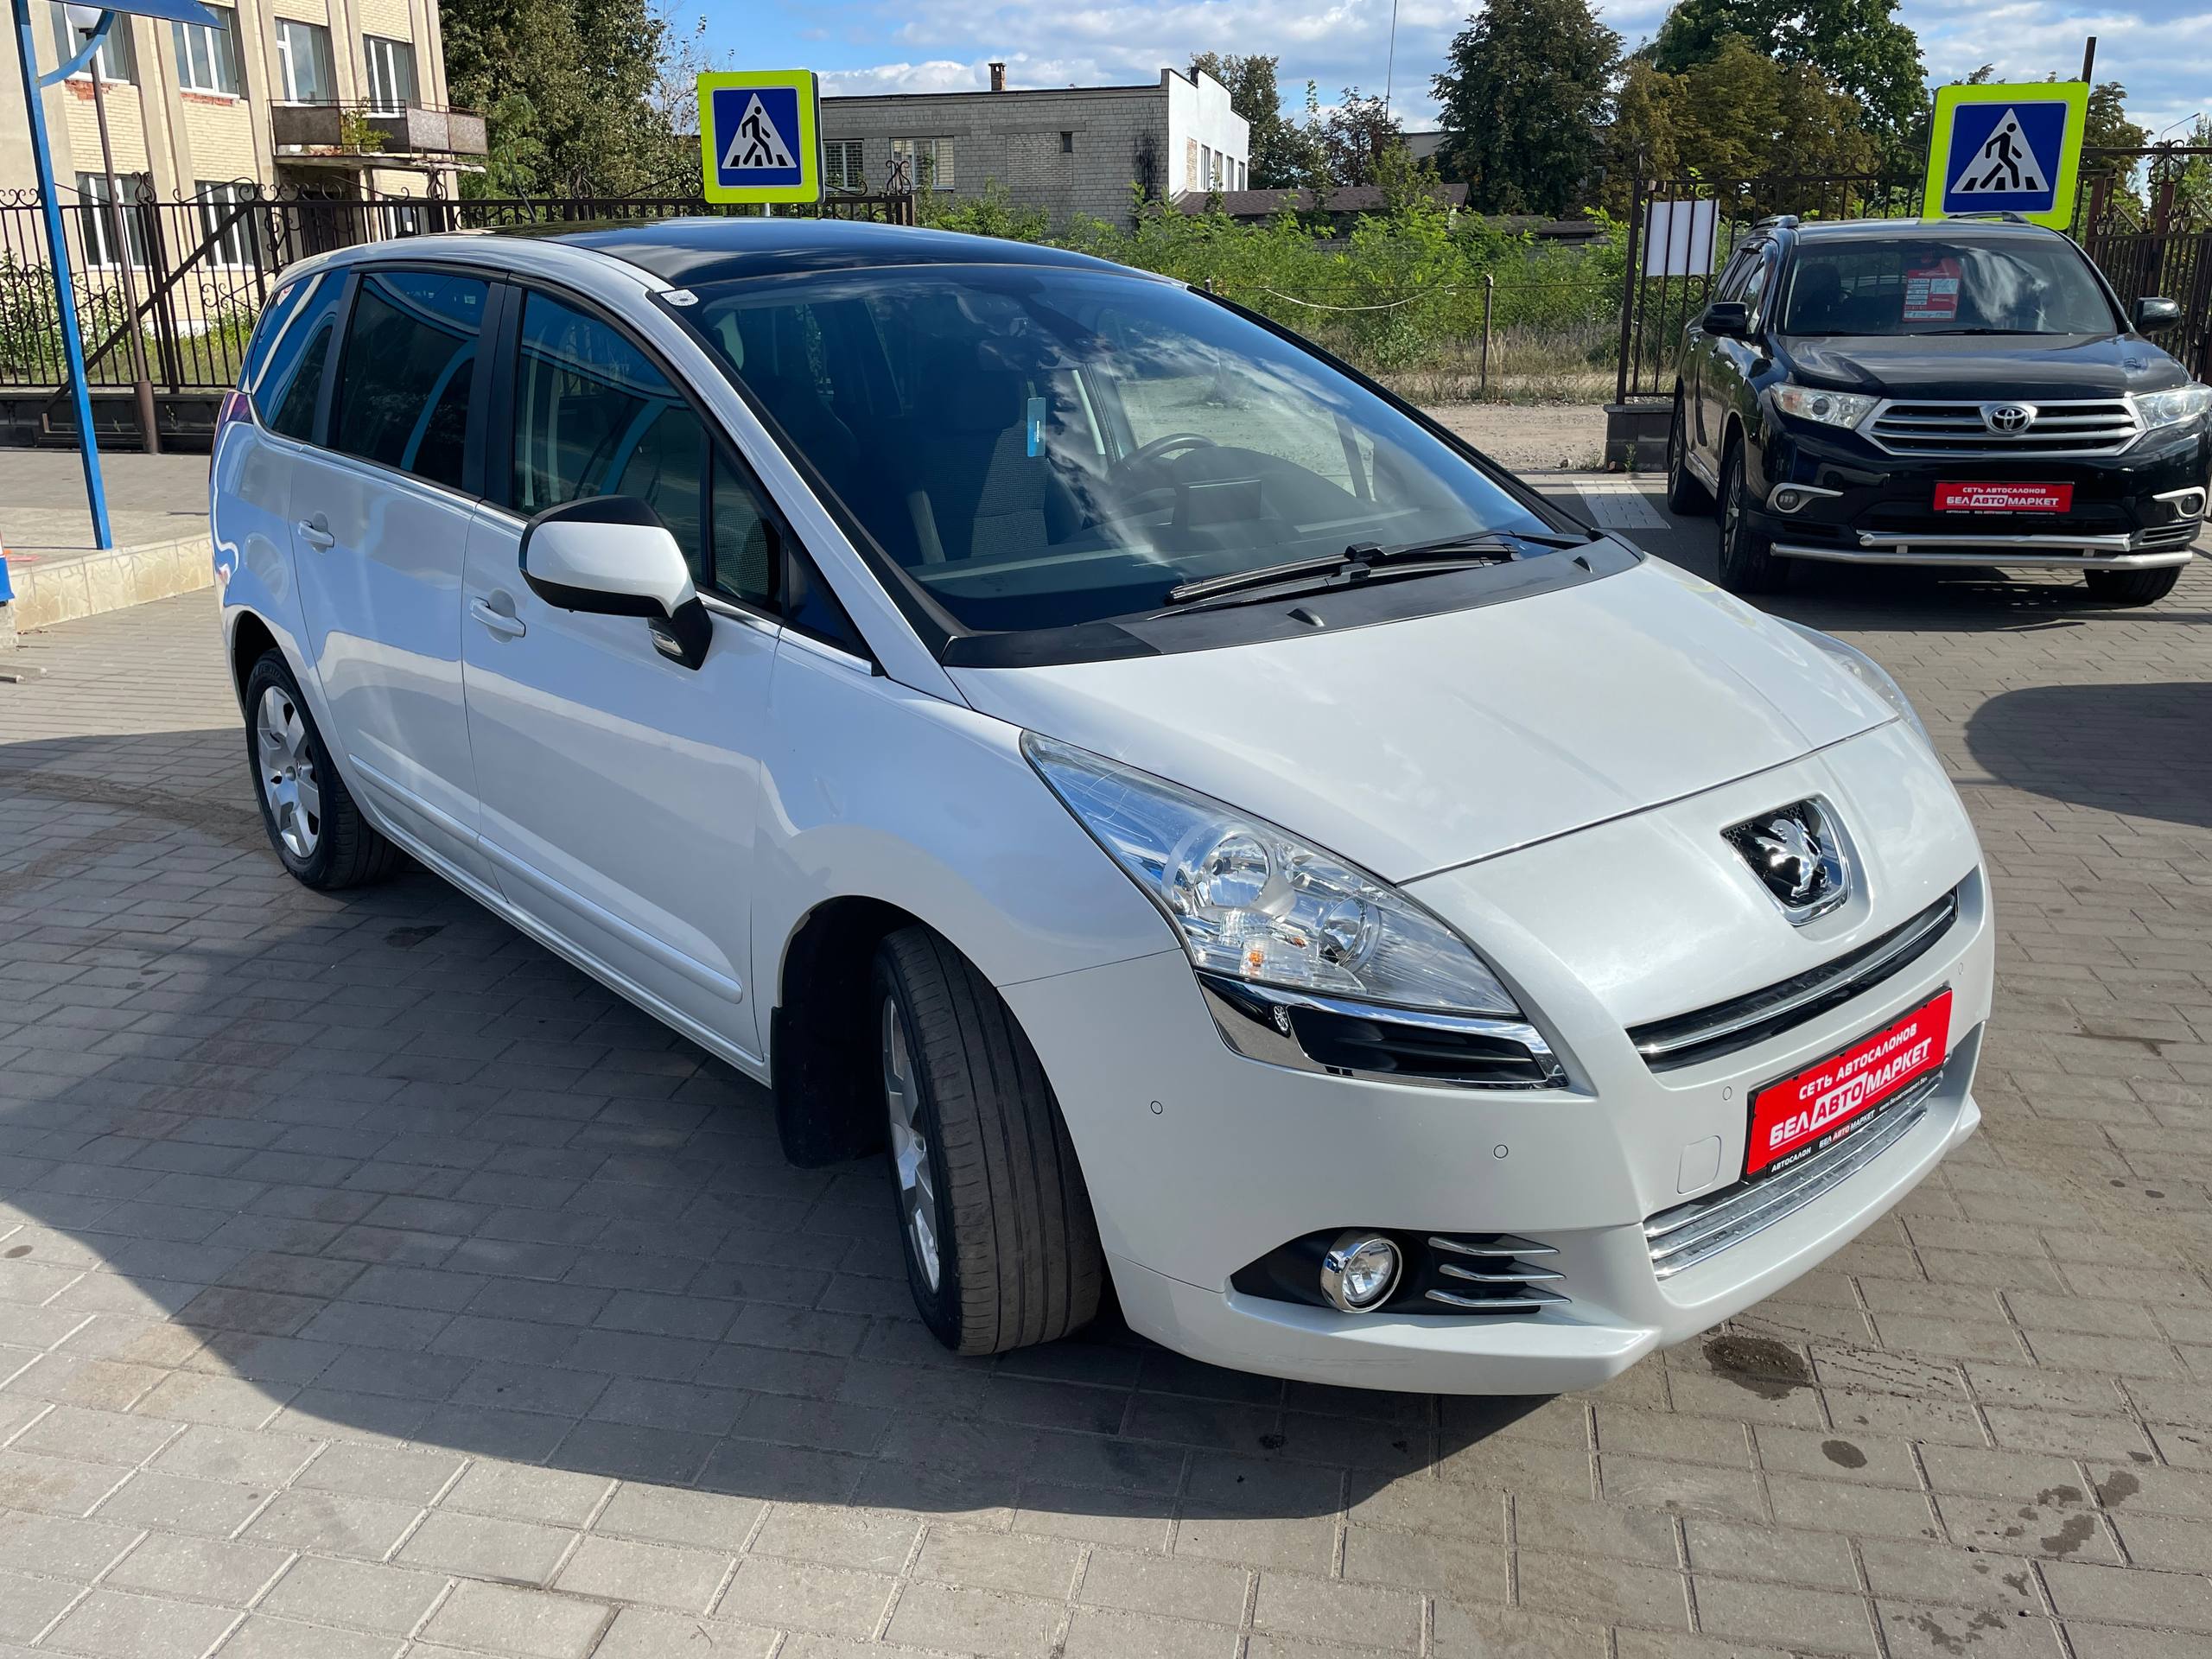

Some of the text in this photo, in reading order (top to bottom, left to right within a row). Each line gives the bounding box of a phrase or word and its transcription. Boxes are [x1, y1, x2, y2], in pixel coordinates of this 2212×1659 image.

[1799, 1023, 1917, 1100] СЕТЬ АВТОСАЛОНОВ
[1770, 1147, 1812, 1173] АВТОСАЛОН
